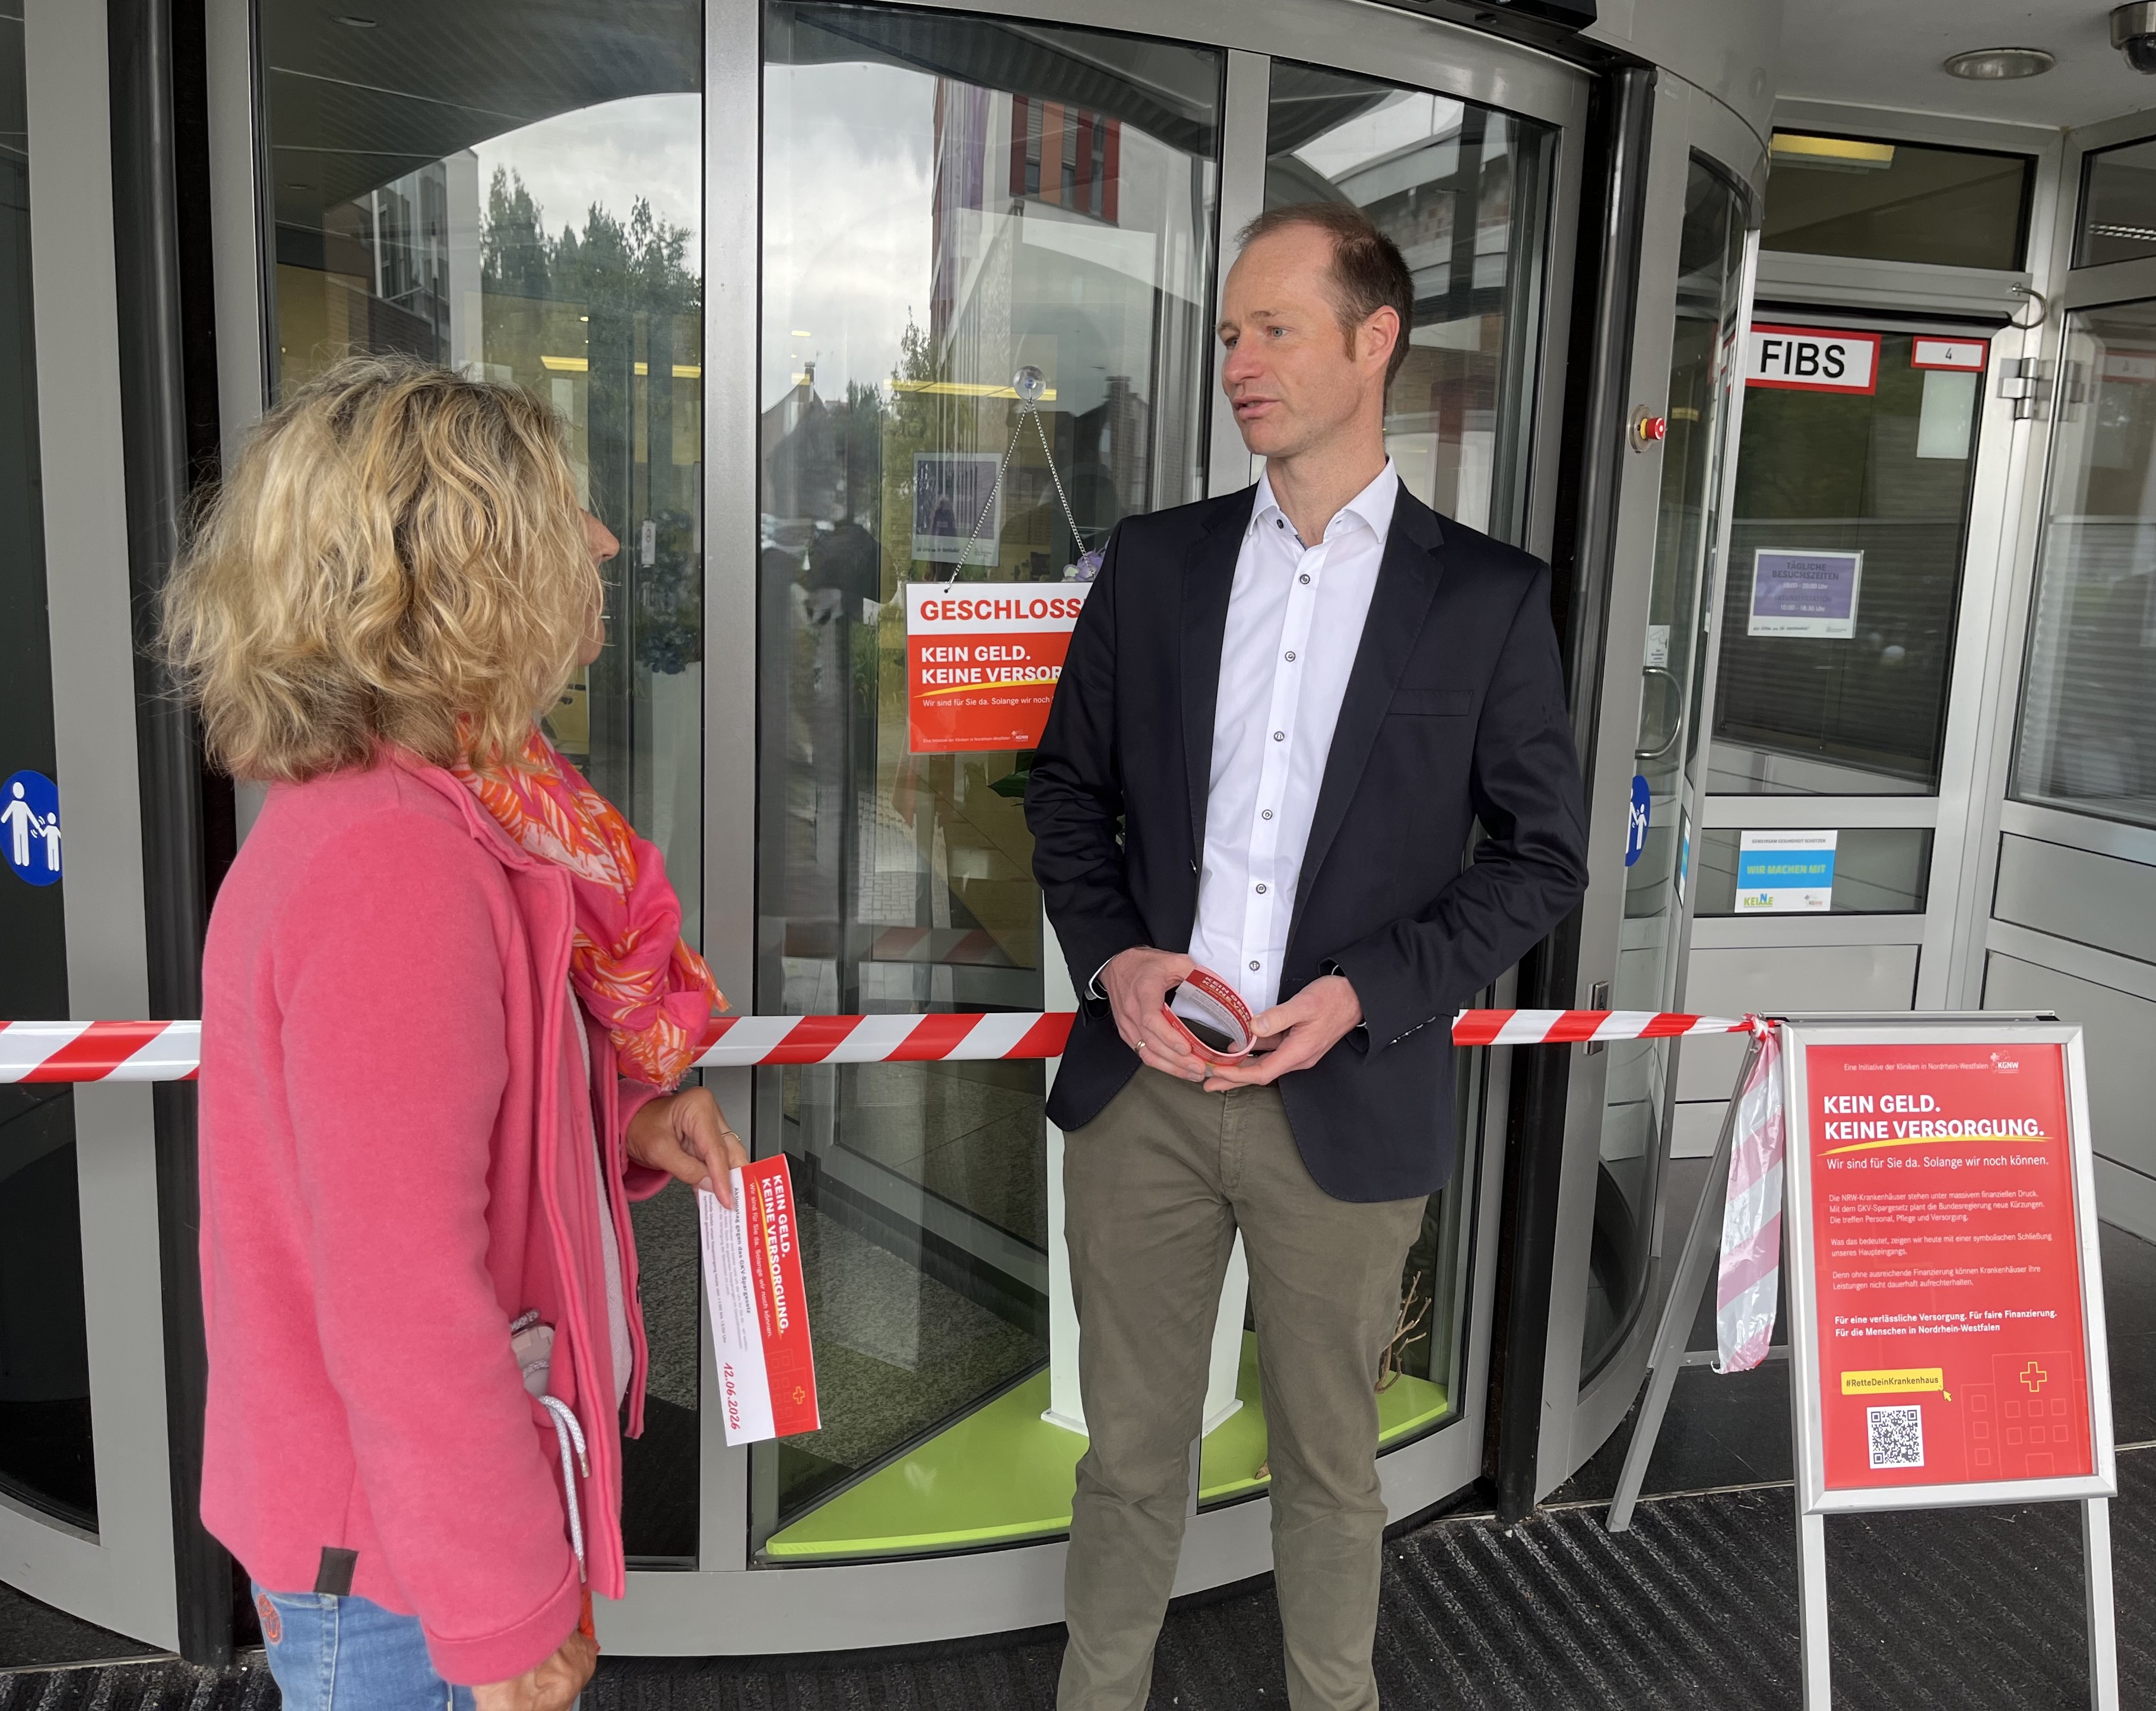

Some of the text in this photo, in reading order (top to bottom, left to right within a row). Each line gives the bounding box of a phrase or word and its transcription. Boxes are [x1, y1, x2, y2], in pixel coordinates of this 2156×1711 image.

[1759, 339, 1846, 378] FIBS
[1945, 347, 1953, 361] 4
[1786, 561, 1827, 571] TÄGLICHE
[1773, 570, 1838, 580] BESUCHSZEITEN
[920, 598, 1086, 621] GESCHLOSS
[921, 646, 1031, 662] KEIN GELD.
[922, 665, 1063, 684] KEINE VERSOR
[991, 697, 1019, 706] Solange
[1747, 864, 1827, 874] WIR MACHEN MIT
[1204, 976, 1229, 994] KEIN
[1928, 1062, 1989, 1070] Nordrhein-Westfalen
[1824, 1094, 1941, 1114] KEIN GELD.
[1825, 1118, 2044, 1139] KEINE VERSORGUNG.
[1827, 1154, 2049, 1169] Wir sind für Sie da. Solange wir noch können.
[1841, 1192, 1906, 1202] NRW-Krankenhäuser
[1981, 1190, 2017, 1198] finanziellen
[2018, 1189, 2039, 1198] Druck.
[1857, 1203, 1908, 1213] GKV-Spargesetz
[1910, 1202, 1926, 1212] plant
[1938, 1201, 1992, 1211] Bundesregierung
[2010, 1200, 2046, 1210] Kürzungen.
[772, 1174, 792, 1258] KEIN GELD.
[1830, 1216, 1841, 1224] Die
[1842, 1215, 1863, 1223] treffen
[1865, 1214, 1895, 1223] Personal,
[1896, 1214, 1916, 1224] Pflege
[1931, 1213, 1969, 1223] Versorgung.
[1859, 1237, 1889, 1245] bedeutet,
[1891, 1236, 1911, 1245] zeigen
[1923, 1235, 1942, 1243] heute
[1973, 1233, 2016, 1243] symbolischen
[2017, 1232, 2052, 1242] Schließung
[761, 1178, 790, 1334] KEINE VERSORGUNG.
[1858, 1248, 1908, 1258] Haupteingangs.
[754, 1249, 763, 1277] Solange
[1869, 1269, 1912, 1278] ausreichende
[1913, 1268, 1954, 1277] Finanzierung
[1955, 1266, 1979, 1275] können
[1980, 1265, 2027, 1274] Krankenhäuser
[1833, 1282, 1868, 1291] Leistungen
[1887, 1280, 1918, 1288] dauerhaft
[1920, 1278, 1974, 1287] aufrechterhalten.
[760, 1291, 769, 1309] noch
[1834, 1309, 2057, 1325] Für eine verlässliche Versorgung. Für faire Finanzierung.
[763, 1310, 772, 1339] können.
[1835, 1323, 2000, 1337] Für die Menschen in Nordrhein-Westfalen
[1846, 1376, 1939, 1388] #RetteDeinKrankenhaus
[723, 1361, 741, 1430] 12.06.2026
